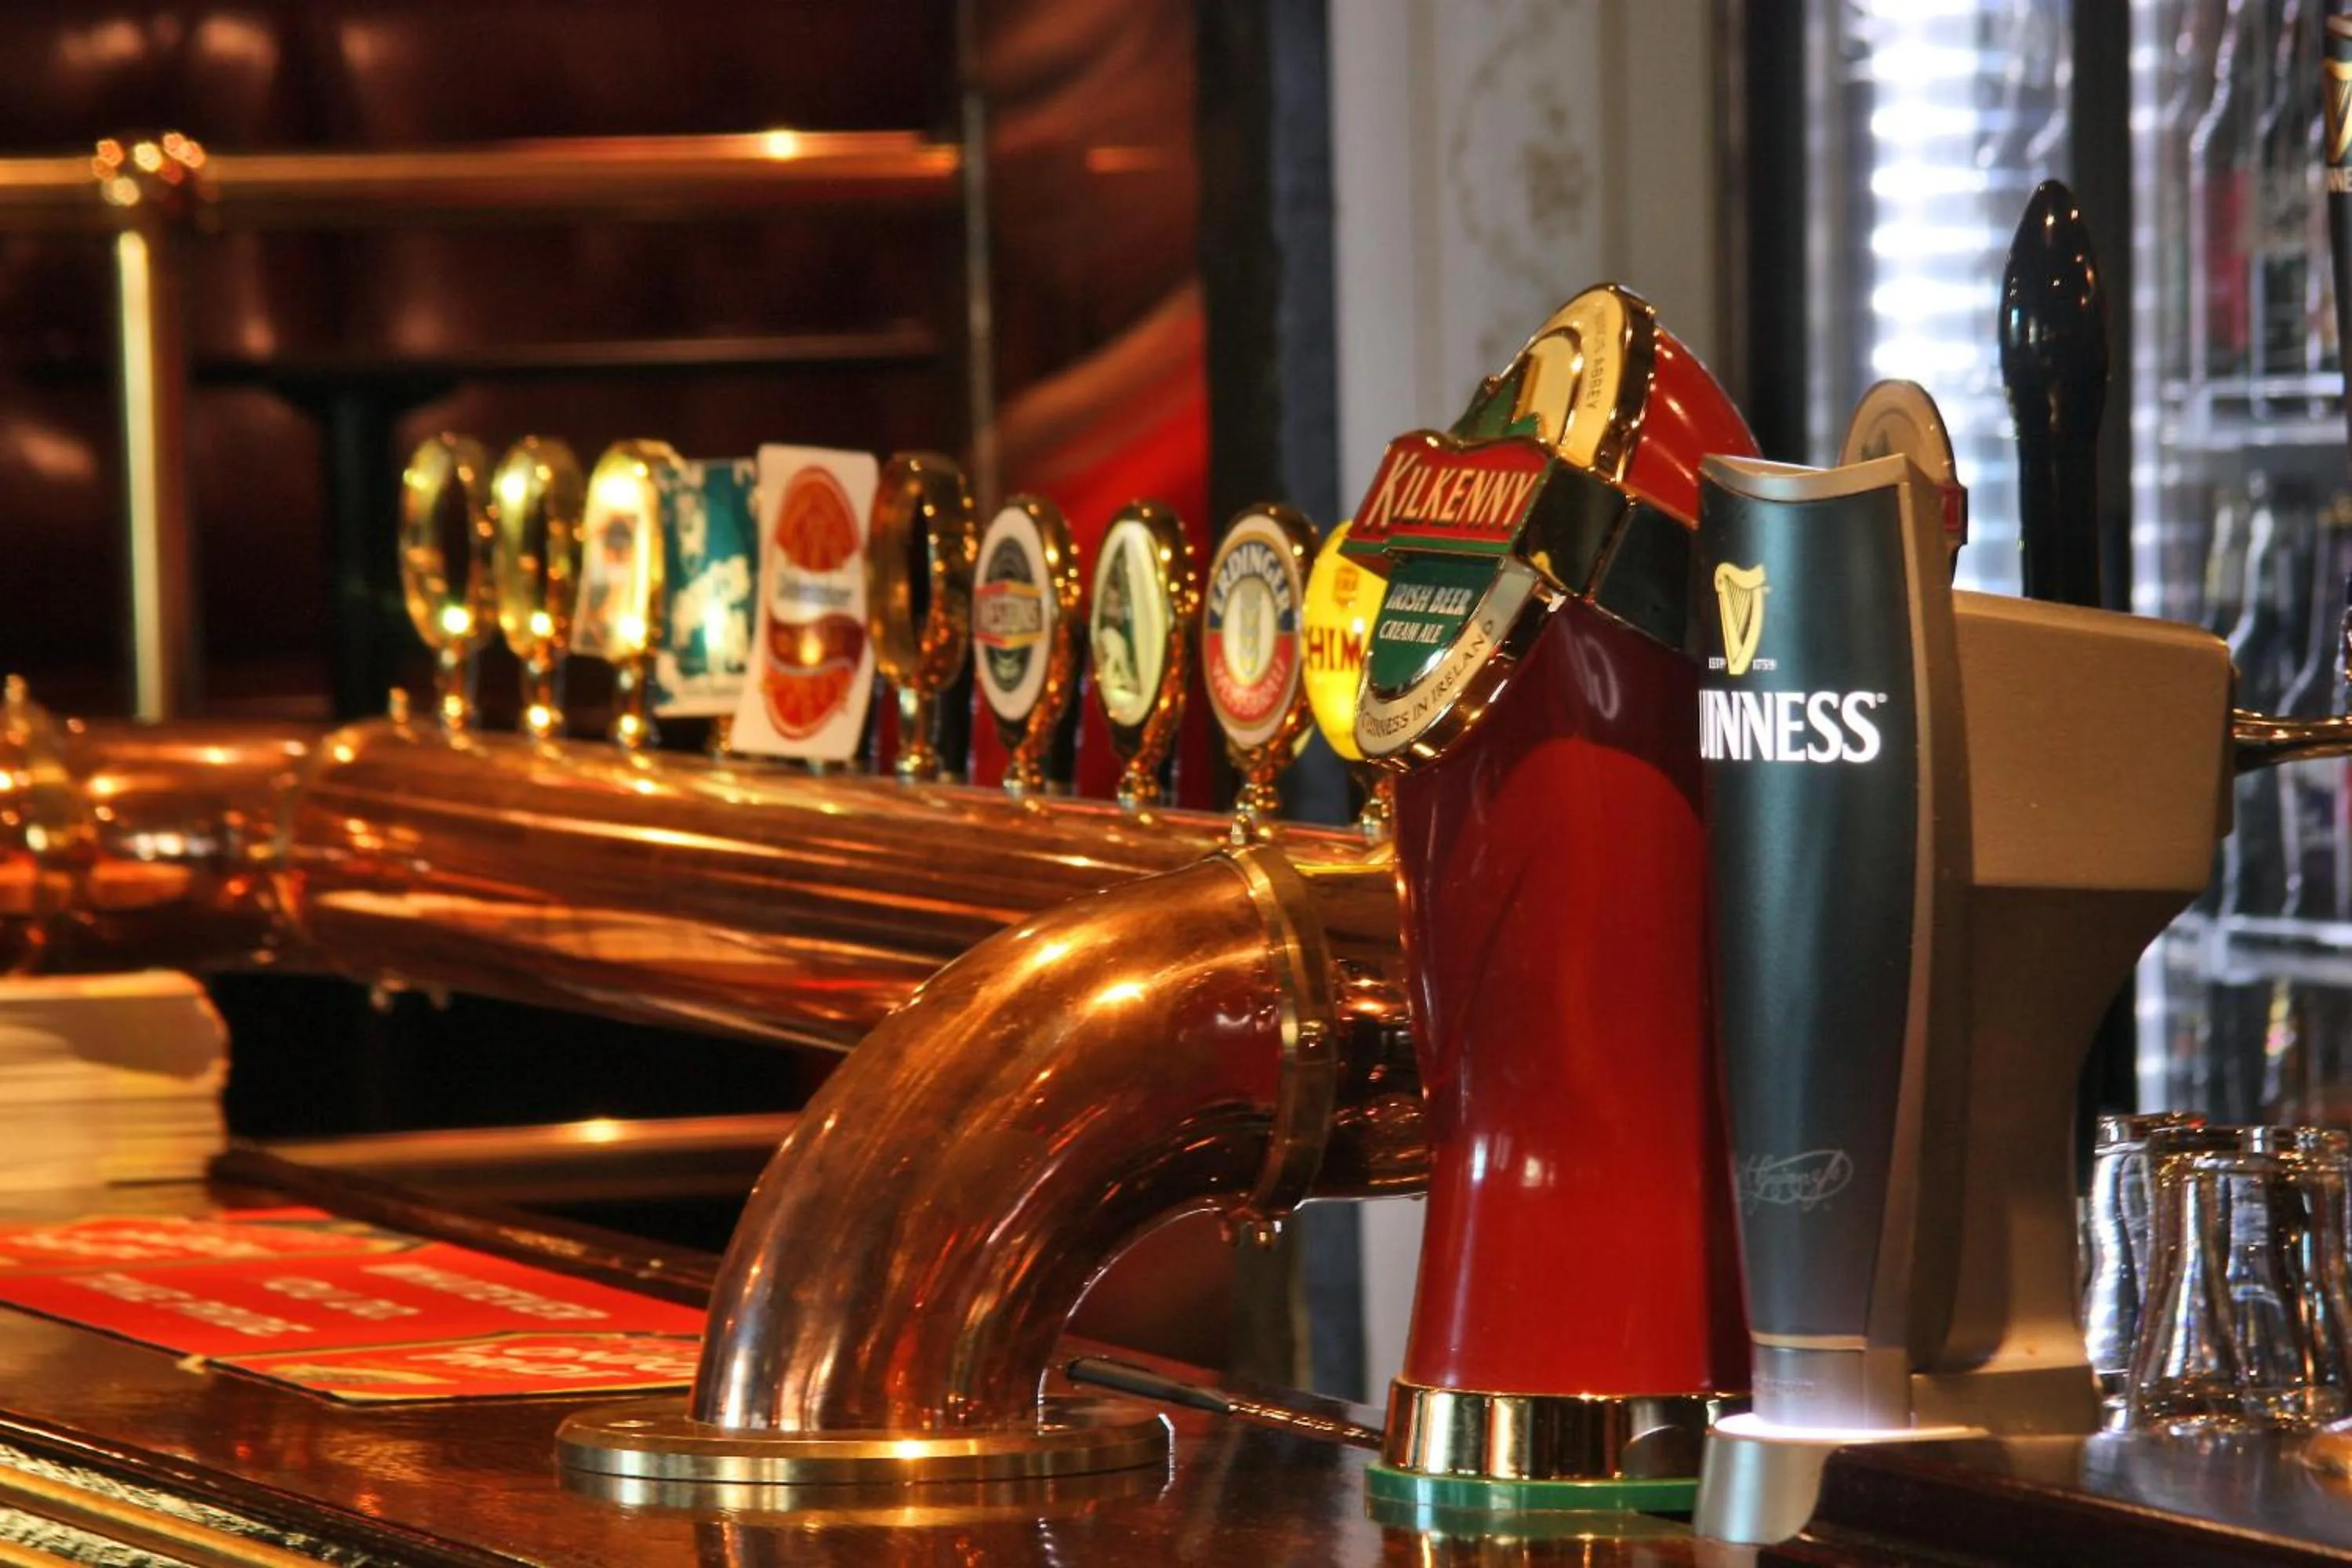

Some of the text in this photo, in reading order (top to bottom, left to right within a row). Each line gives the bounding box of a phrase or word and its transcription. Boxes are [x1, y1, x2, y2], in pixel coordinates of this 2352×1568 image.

[1364, 452, 1539, 530] KILKENNY
[1385, 583, 1474, 615] IRISH BEER
[1304, 626, 1364, 671] HIM
[1378, 620, 1445, 644] CREAM ALE
[1412, 699, 1429, 722] IN
[1432, 619, 1494, 703] IRELAND
